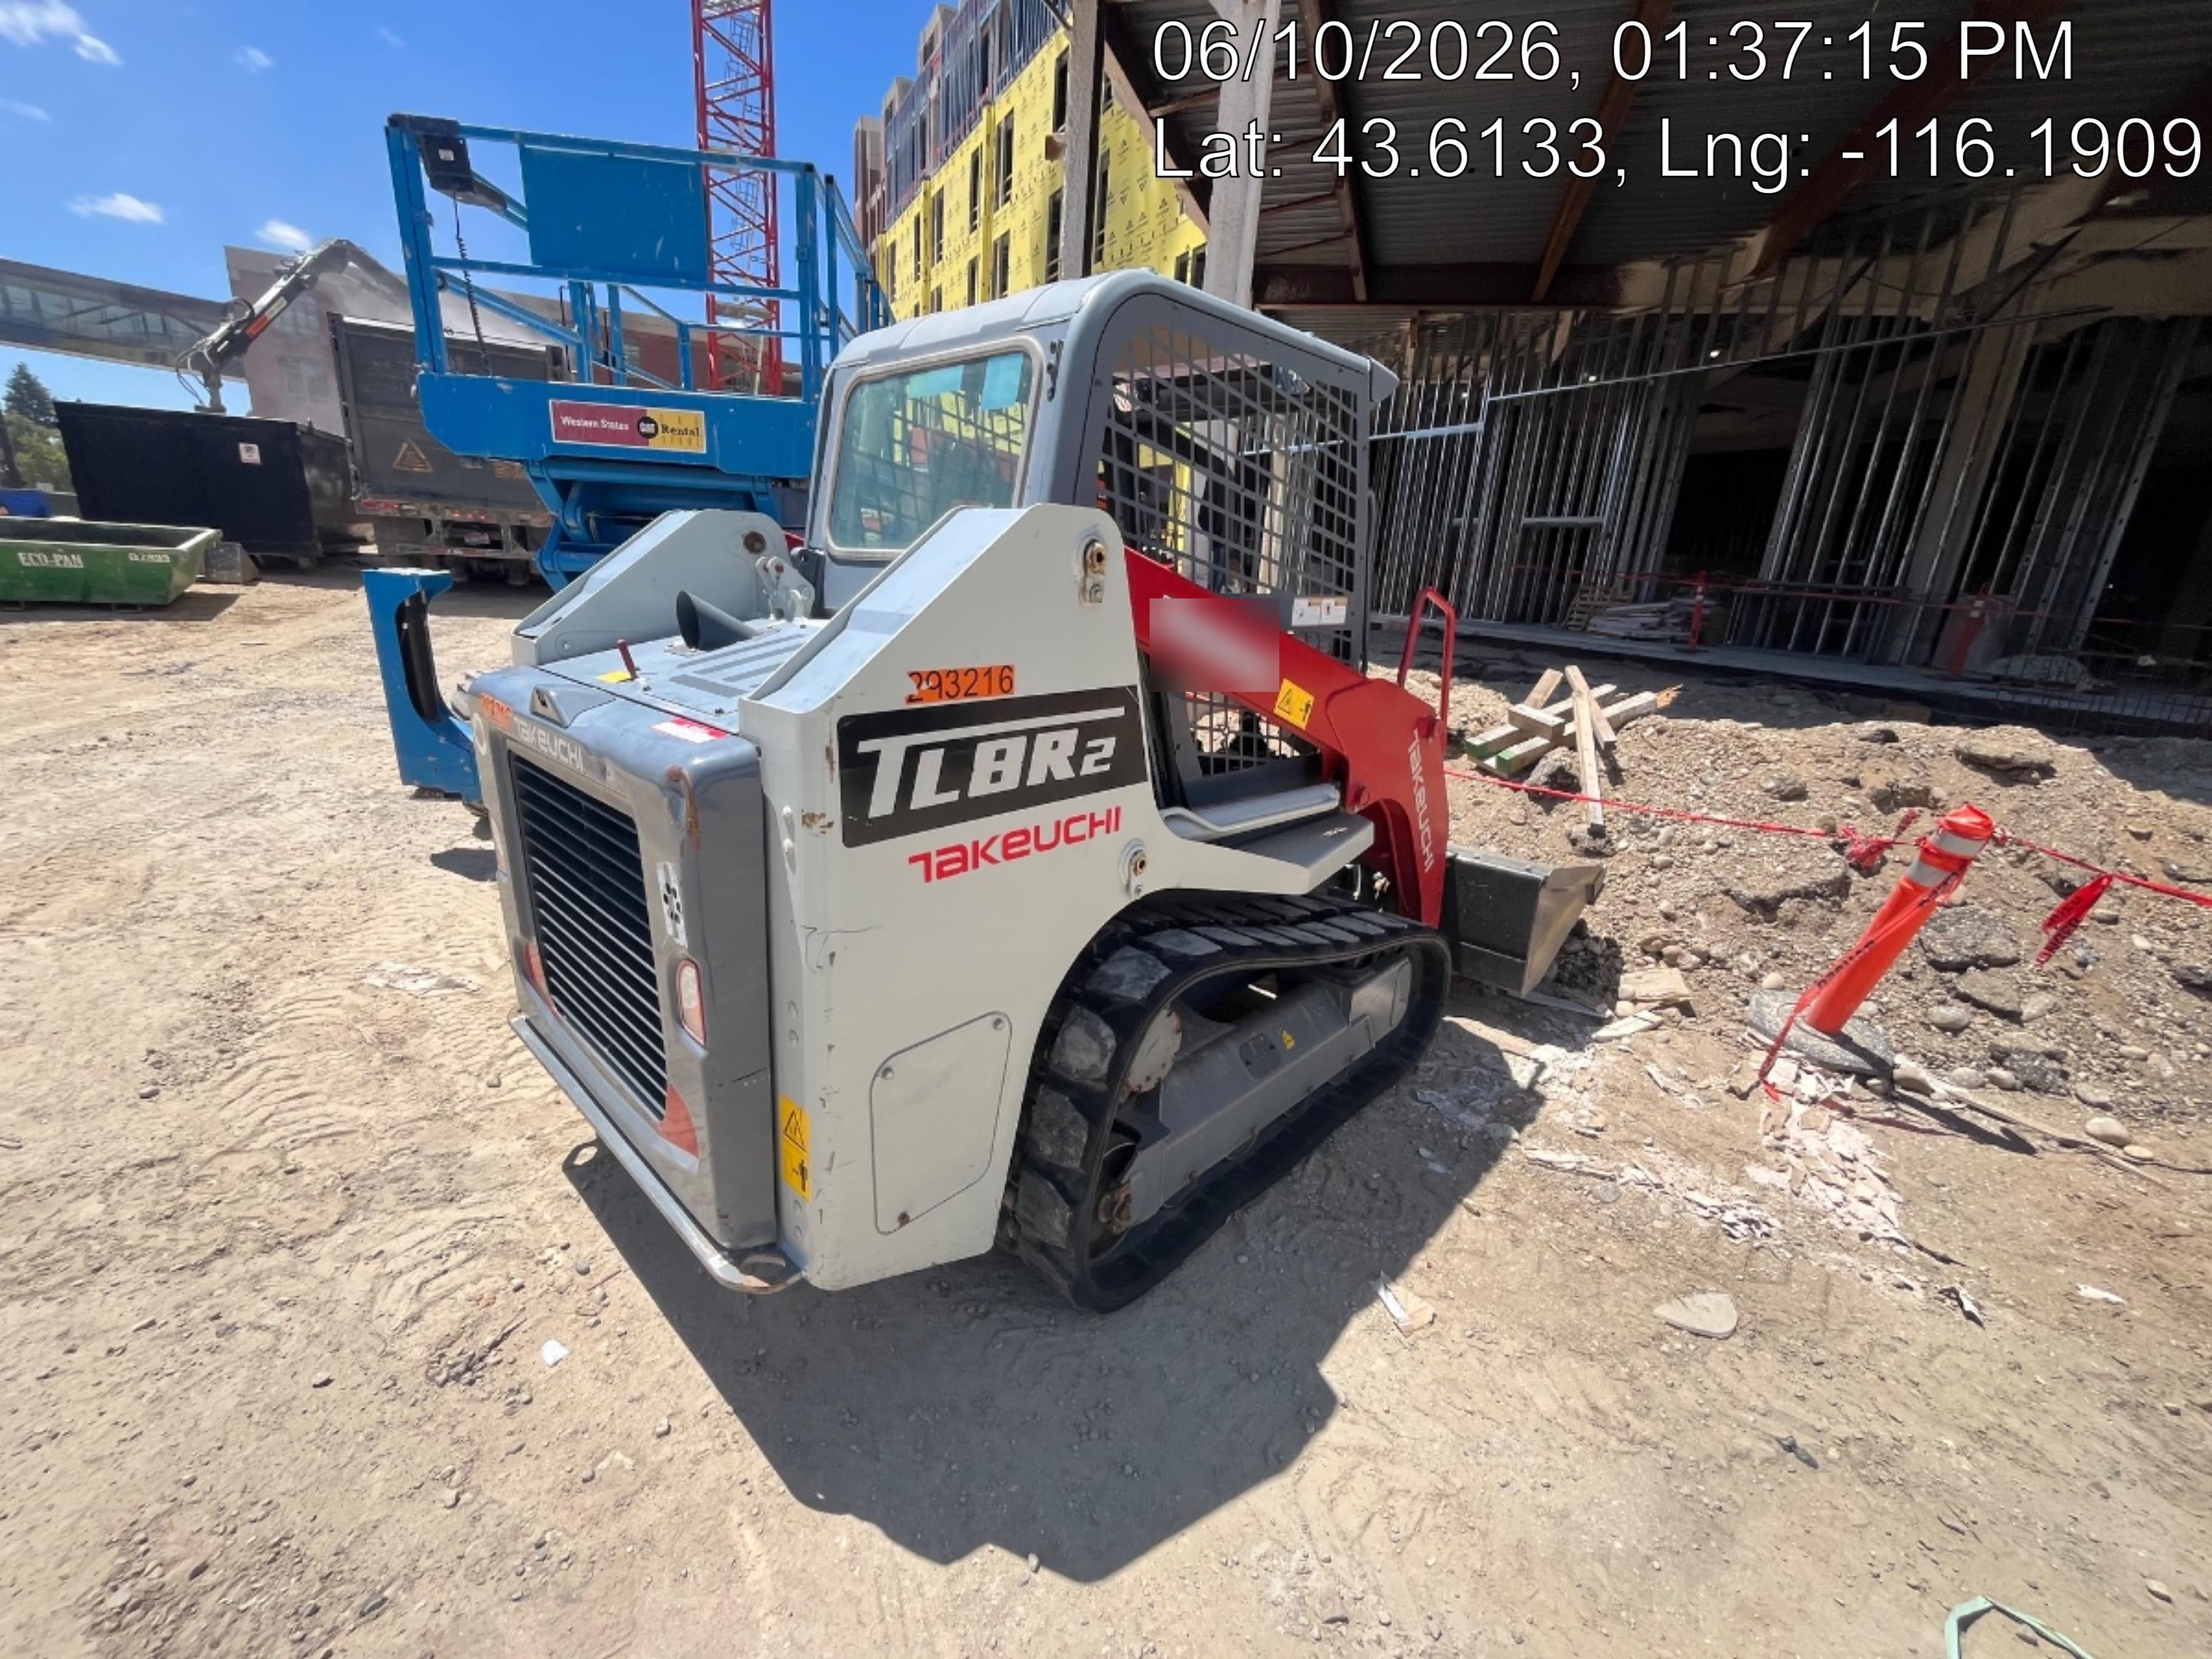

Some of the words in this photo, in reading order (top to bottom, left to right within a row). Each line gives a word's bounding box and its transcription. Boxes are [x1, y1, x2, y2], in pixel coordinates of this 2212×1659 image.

[560, 415, 599, 428] Western
[600, 418, 630, 431] States
[661, 423, 700, 436] Rental
[18, 552, 84, 568] ECO-PAN
[906, 665, 1013, 702] 293216
[514, 716, 584, 771] TAKEUCHI
[857, 706, 1125, 819] TL8R2
[908, 806, 1122, 884] TAKEUCHI
